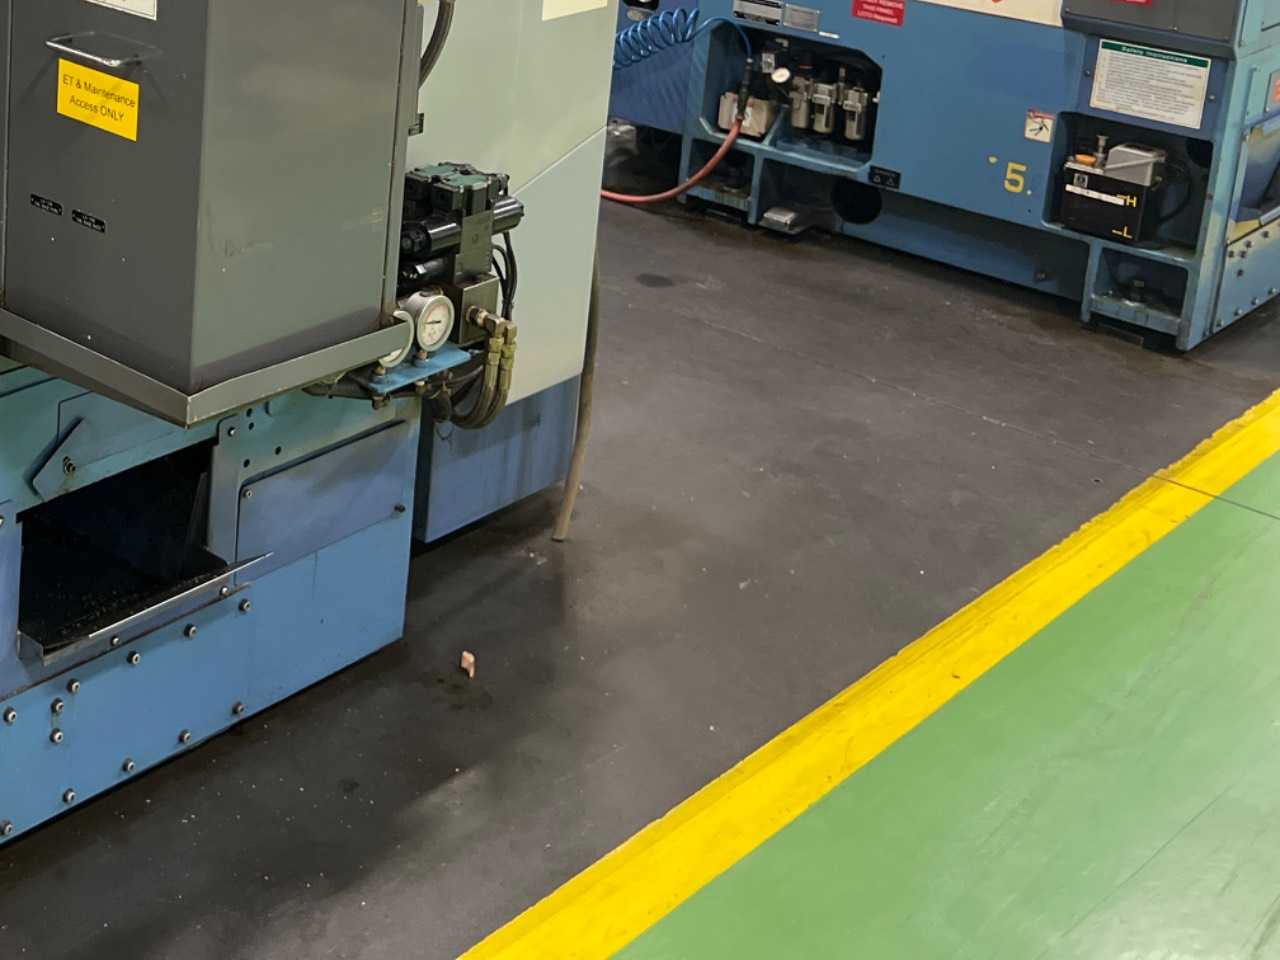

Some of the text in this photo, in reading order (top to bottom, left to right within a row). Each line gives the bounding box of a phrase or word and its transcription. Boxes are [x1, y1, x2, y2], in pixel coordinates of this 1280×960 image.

[63, 74, 74, 86] ET
[83, 80, 136, 108] Maintenance
[69, 95, 125, 122] Access ONLY
[1004, 161, 1027, 193] 5
[1126, 194, 1137, 208] H
